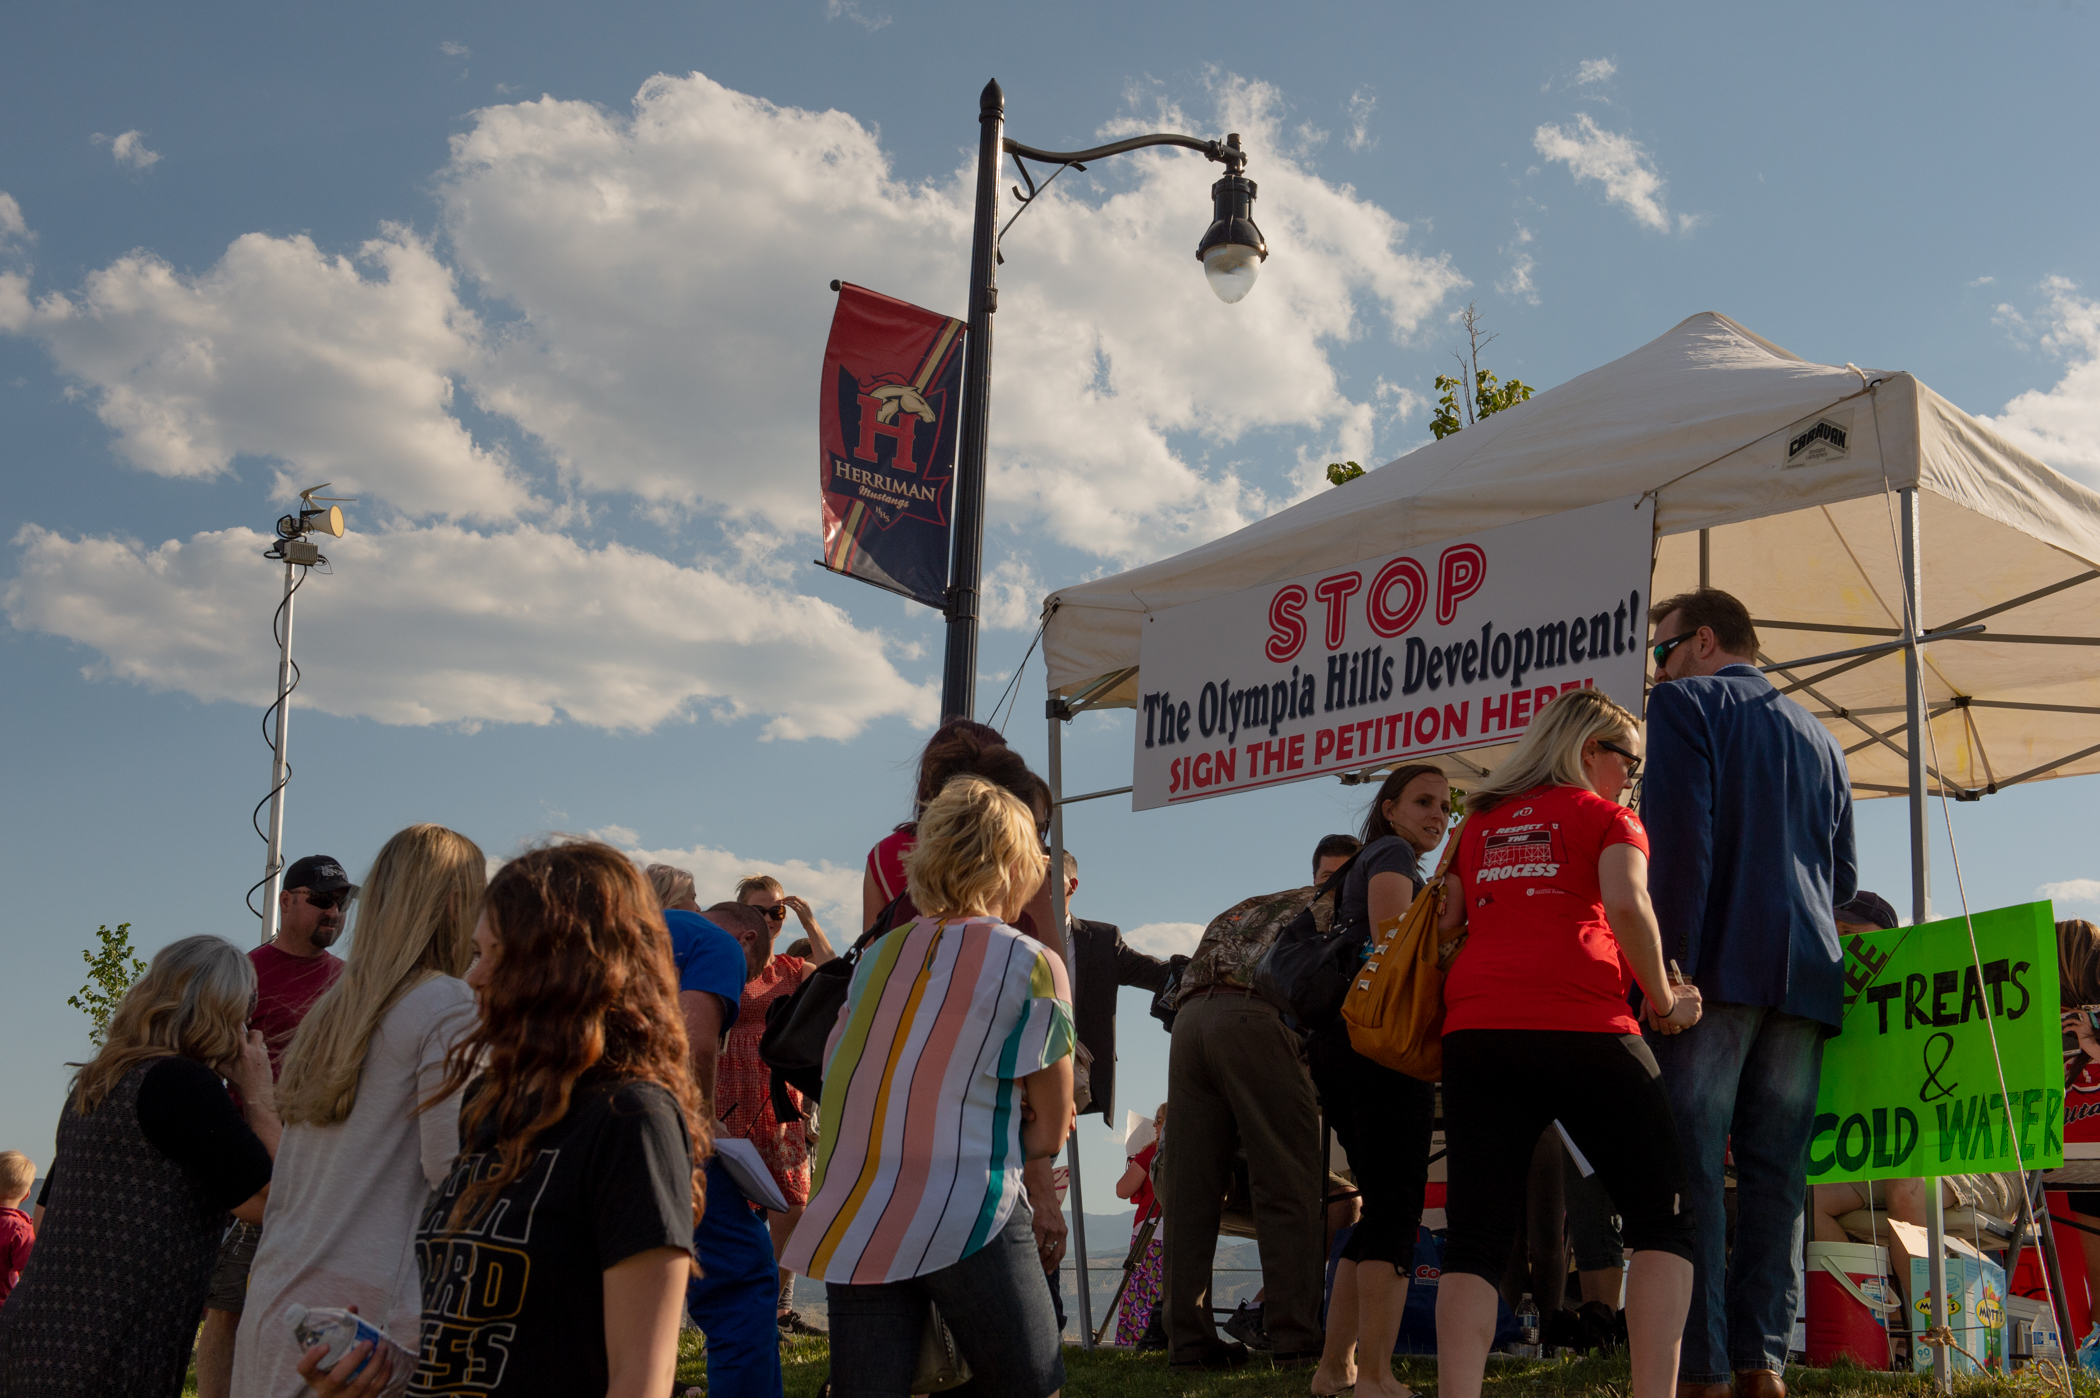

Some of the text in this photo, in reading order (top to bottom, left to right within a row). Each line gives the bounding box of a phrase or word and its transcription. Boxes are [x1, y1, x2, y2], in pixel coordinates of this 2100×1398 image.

[1789, 422, 1847, 457] CARAVAN
[834, 459, 936, 502] HERRIMAN
[858, 484, 909, 509] Mustangs
[875, 506, 890, 523] HHS
[1265, 542, 1488, 664] STOP
[1143, 589, 1640, 748] The Olympia Hills Development!
[1168, 747, 1236, 794] SIGN
[1245, 734, 1304, 780] THE
[1315, 701, 1470, 765] PETITION
[1495, 823, 1544, 834] RESPECT
[1507, 834, 1529, 843] THE
[1476, 862, 1560, 884] PROCESS
[1843, 933, 1888, 1012] EE
[1867, 958, 2031, 1035] TREATS
[1919, 1032, 1958, 1102] &
[1806, 1089, 2062, 1176] COLD WATER
[1917, 1347, 1930, 1358] 90
